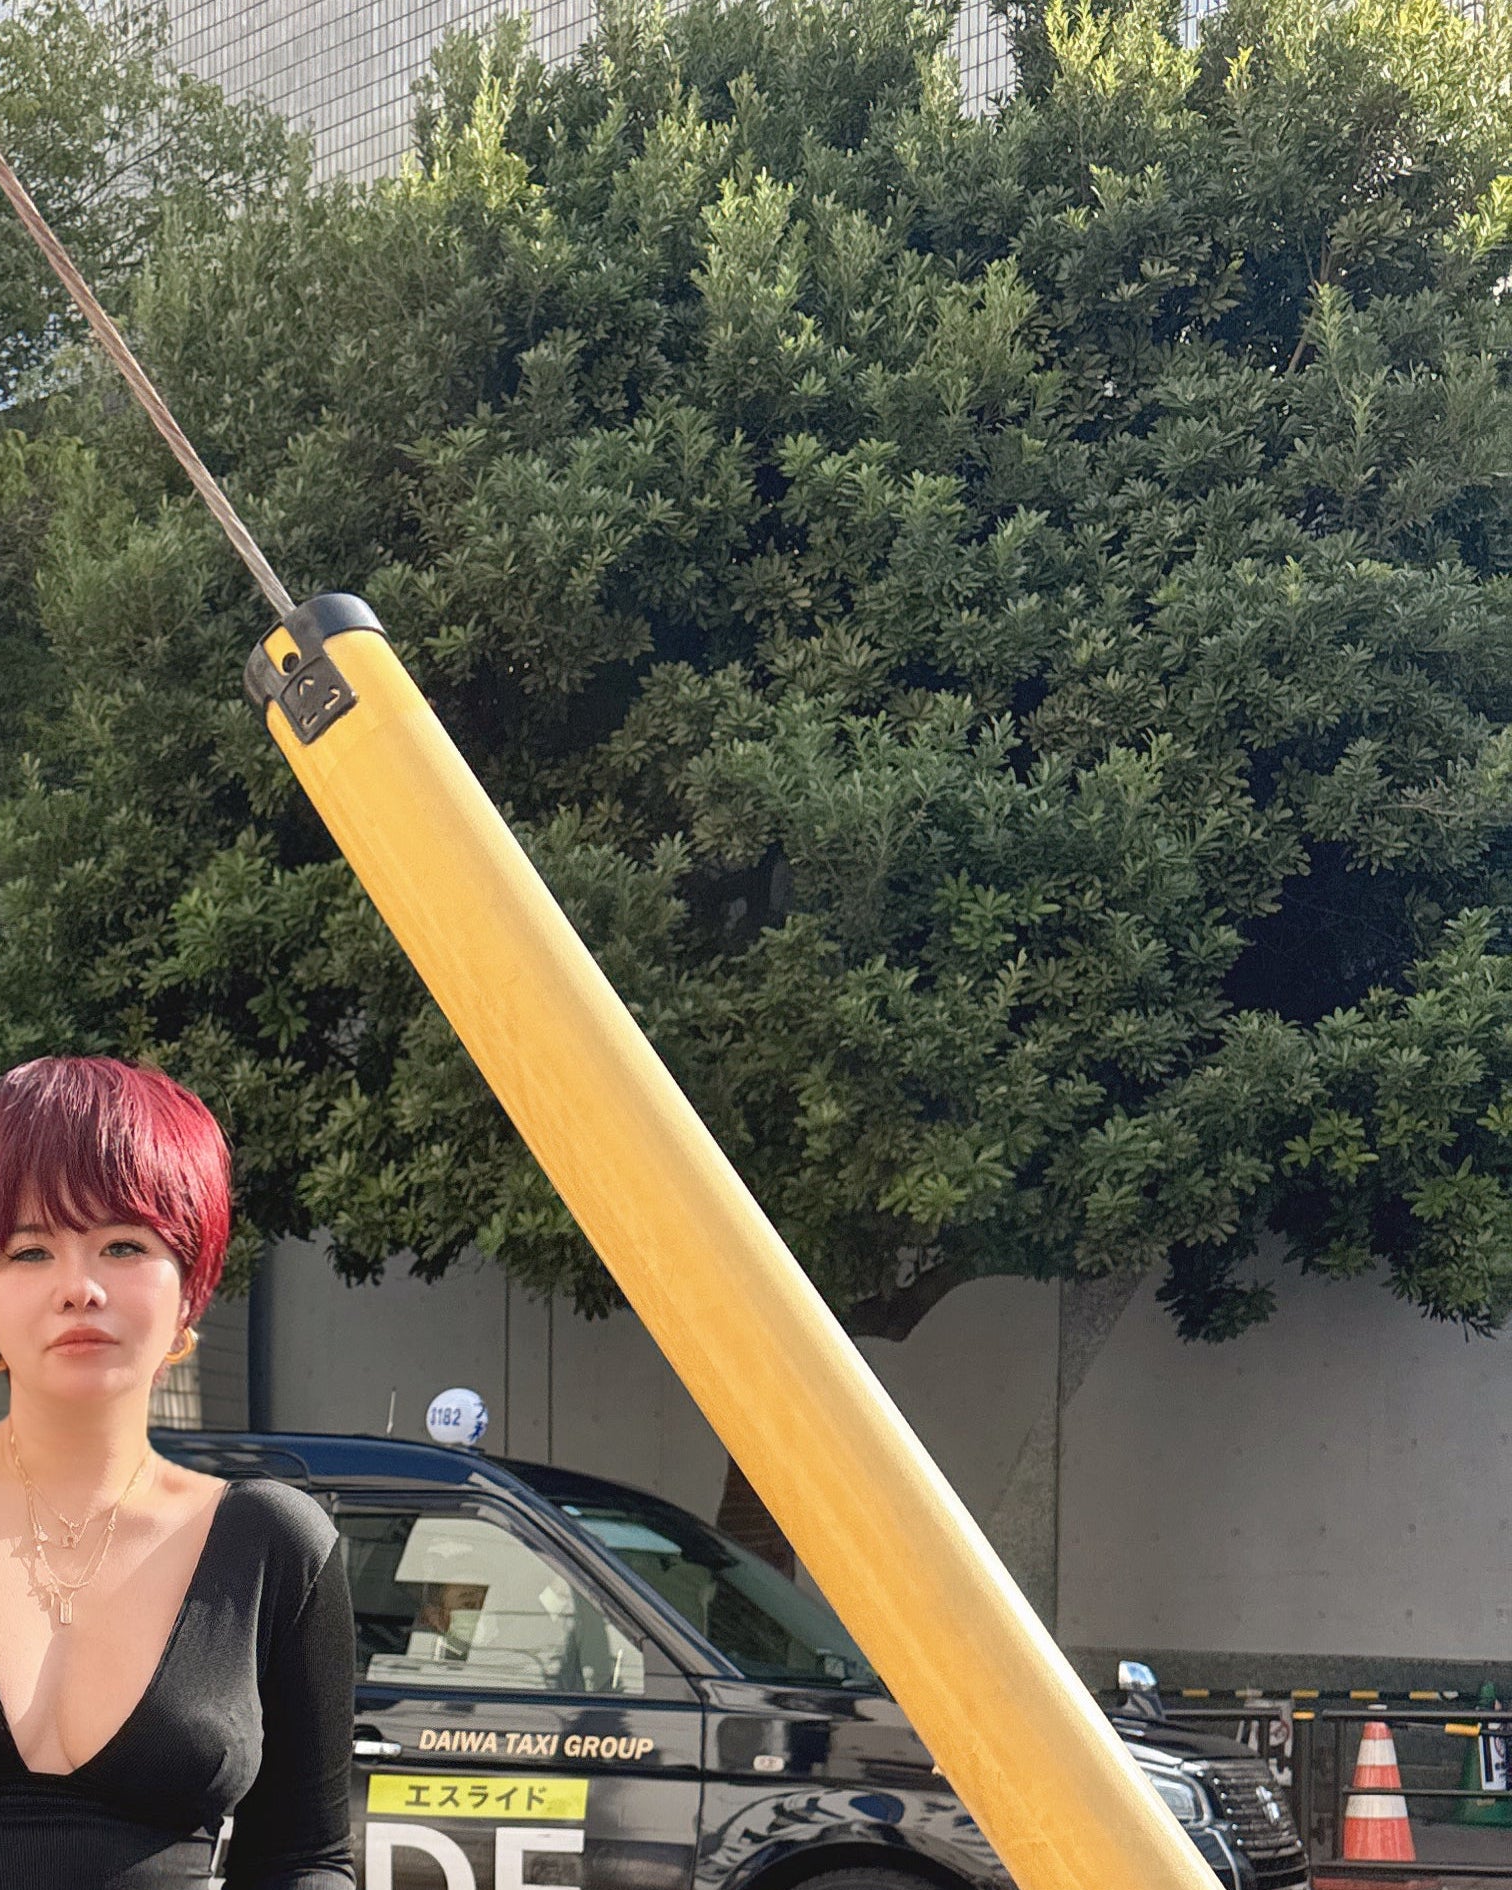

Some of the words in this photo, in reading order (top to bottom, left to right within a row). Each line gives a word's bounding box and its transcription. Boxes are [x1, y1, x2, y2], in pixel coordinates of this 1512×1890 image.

[419, 1729, 497, 1752] DAIWA
[499, 1732, 558, 1756] TAXI
[564, 1735, 654, 1760] GROUP
[405, 1784, 547, 1811] エスライド
